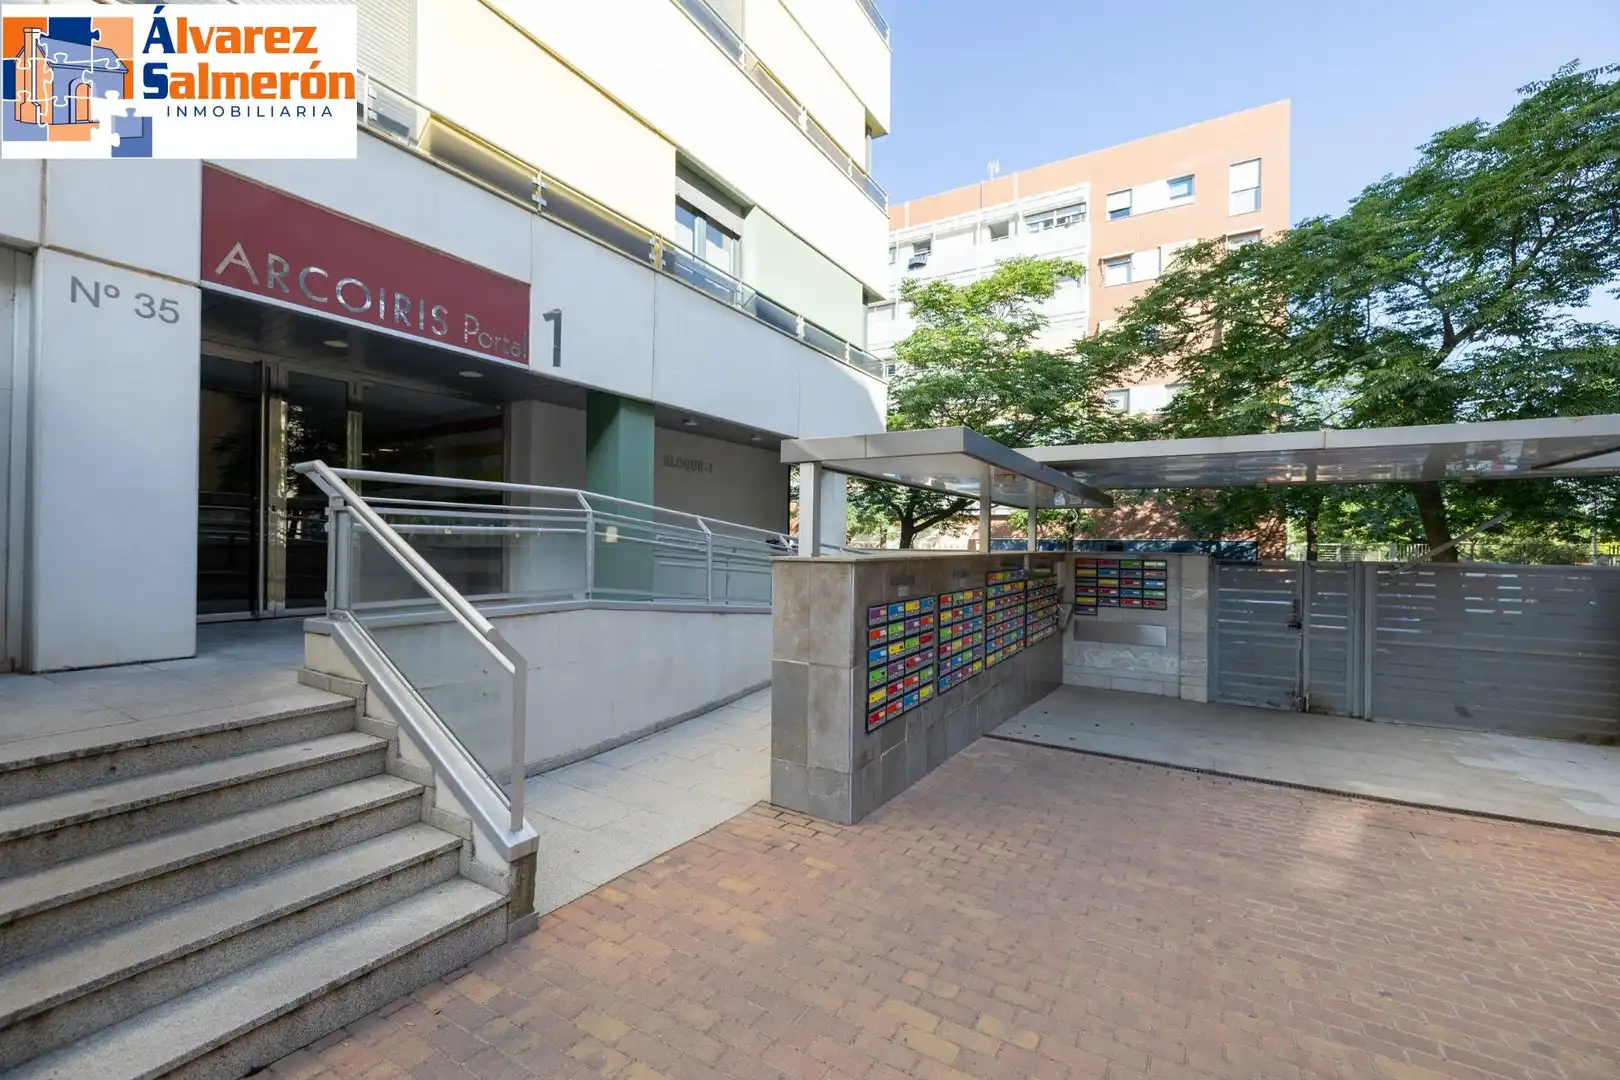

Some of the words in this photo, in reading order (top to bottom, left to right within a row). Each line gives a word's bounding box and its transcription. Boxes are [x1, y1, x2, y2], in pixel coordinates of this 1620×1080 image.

[134, 293, 181, 324] 35
[215, 242, 448, 337] ARCOIRIS
[463, 313, 528, 359] Portal
[542, 308, 562, 367] 1
